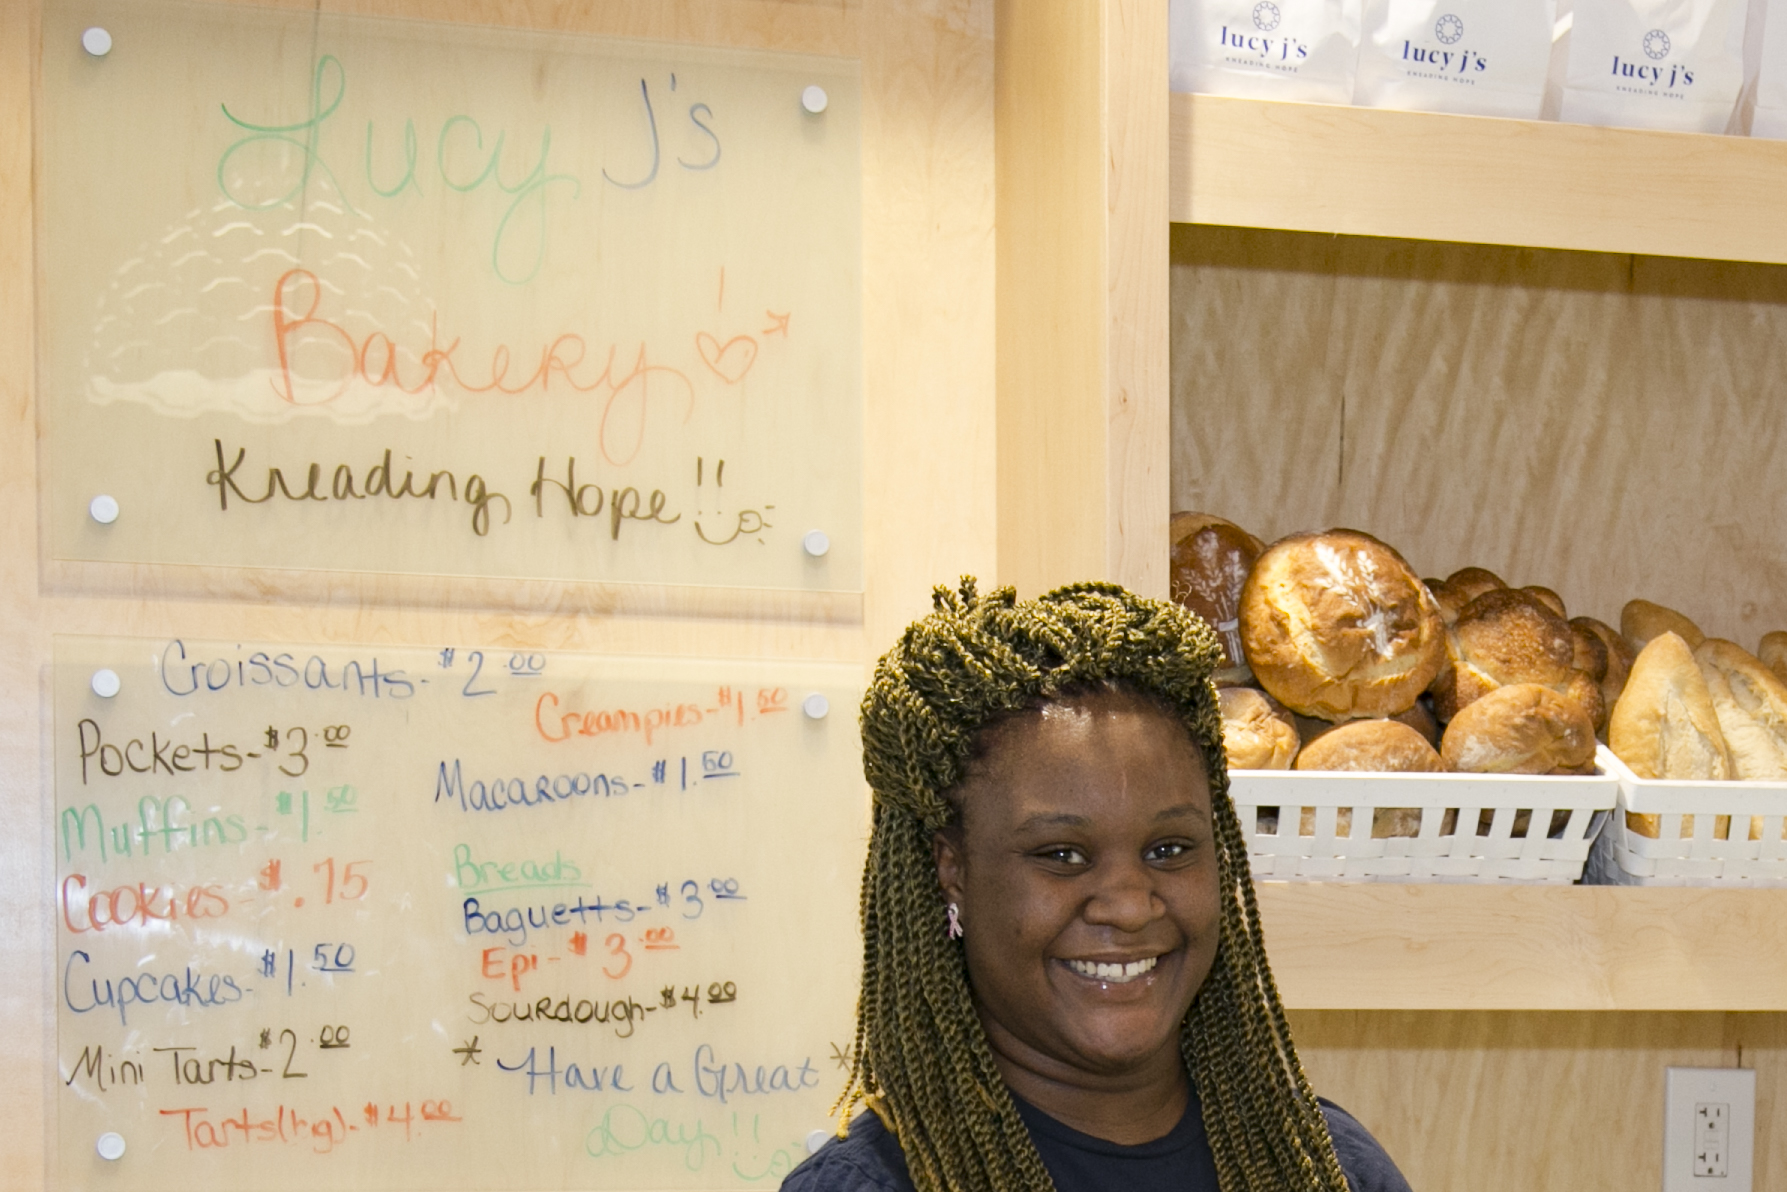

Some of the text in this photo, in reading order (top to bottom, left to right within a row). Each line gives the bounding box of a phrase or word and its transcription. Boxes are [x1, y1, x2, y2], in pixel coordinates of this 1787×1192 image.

[1221, 26, 1274, 58] lucy
[1403, 40, 1454, 71] lucy
[1612, 56, 1663, 86] lucy
[217, 54, 722, 285] Lucy J's
[454, 843, 592, 896] Breads
[66, 1045, 144, 1092] Mini
[496, 1043, 820, 1104] Have a Great
